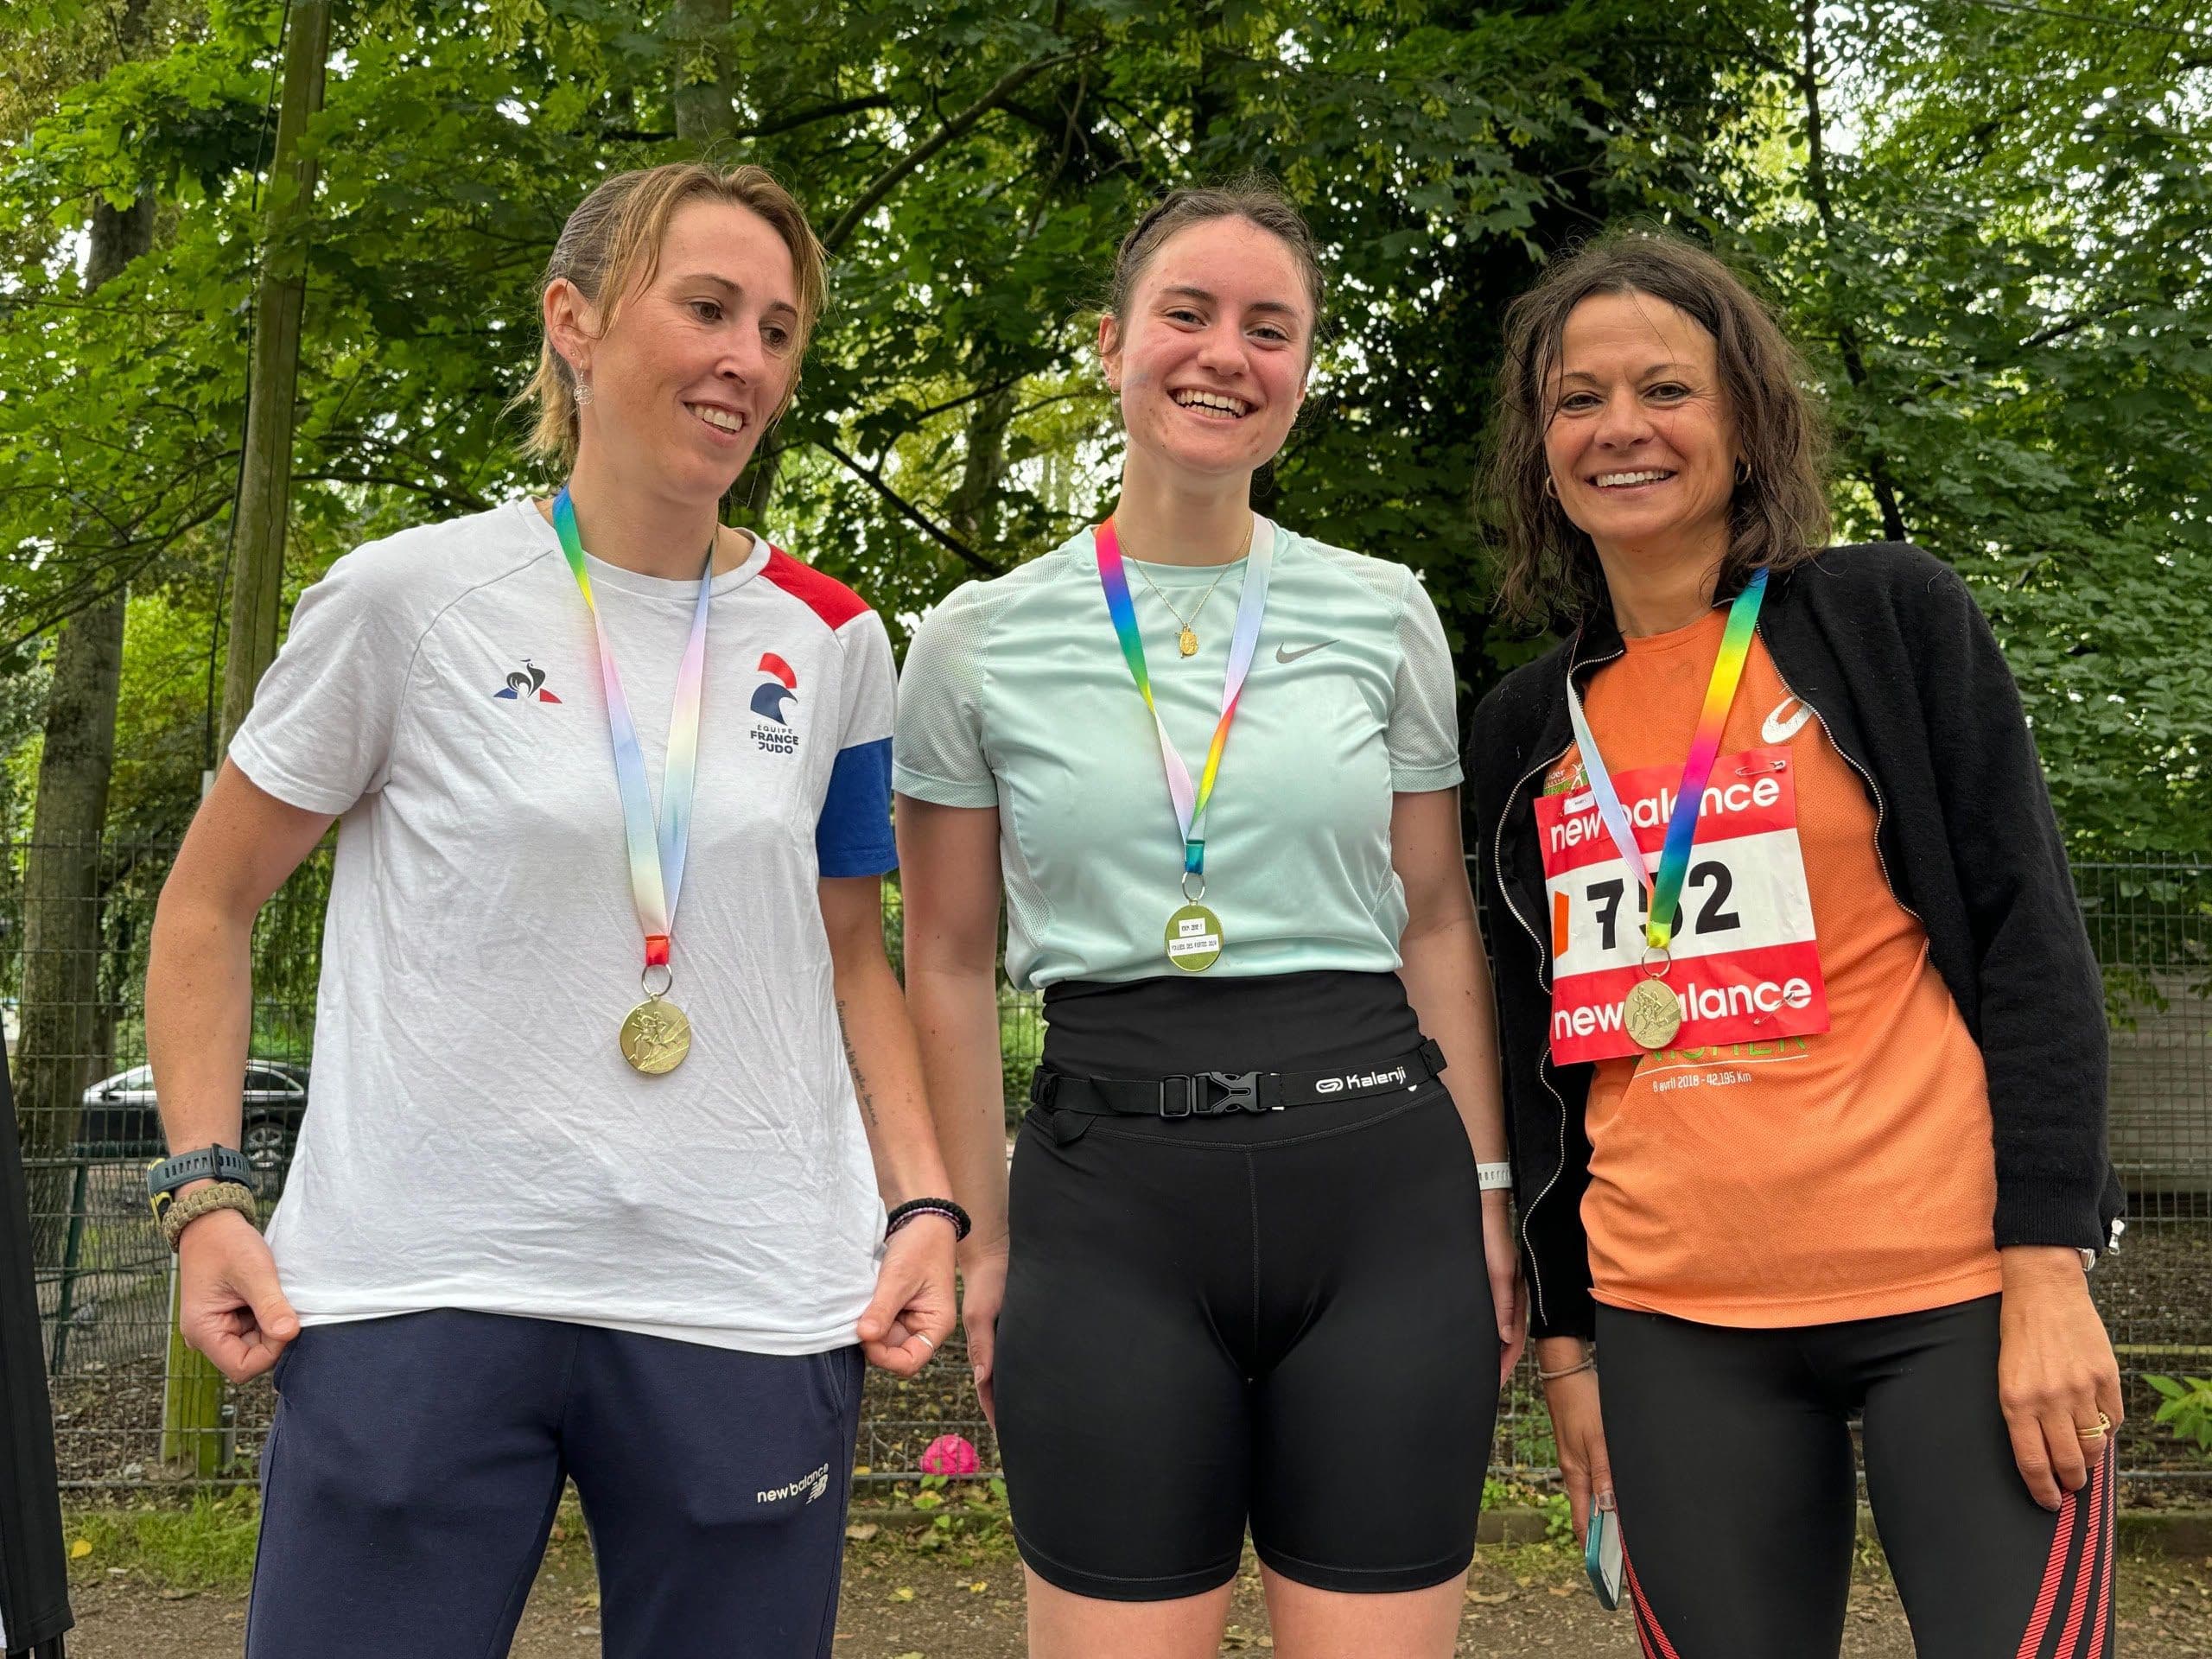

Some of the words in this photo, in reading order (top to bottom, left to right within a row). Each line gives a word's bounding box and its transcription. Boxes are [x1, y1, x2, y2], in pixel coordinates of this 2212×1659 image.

[750, 730, 799, 746] FRANCE
[758, 741, 793, 754] JUDO
[1550, 810, 1600, 854] new
[1619, 778, 1780, 829] alnce
[1554, 1001, 1626, 1040] new
[1677, 977, 1812, 1023] lance
[1346, 1065, 1407, 1090] Kalenji
[1659, 1077, 1676, 1092] avril
[1677, 1074, 1700, 1089] 2018
[1736, 1070, 1752, 1083] Km
[757, 1487, 789, 1503] new
[788, 1462, 829, 1497] balance
